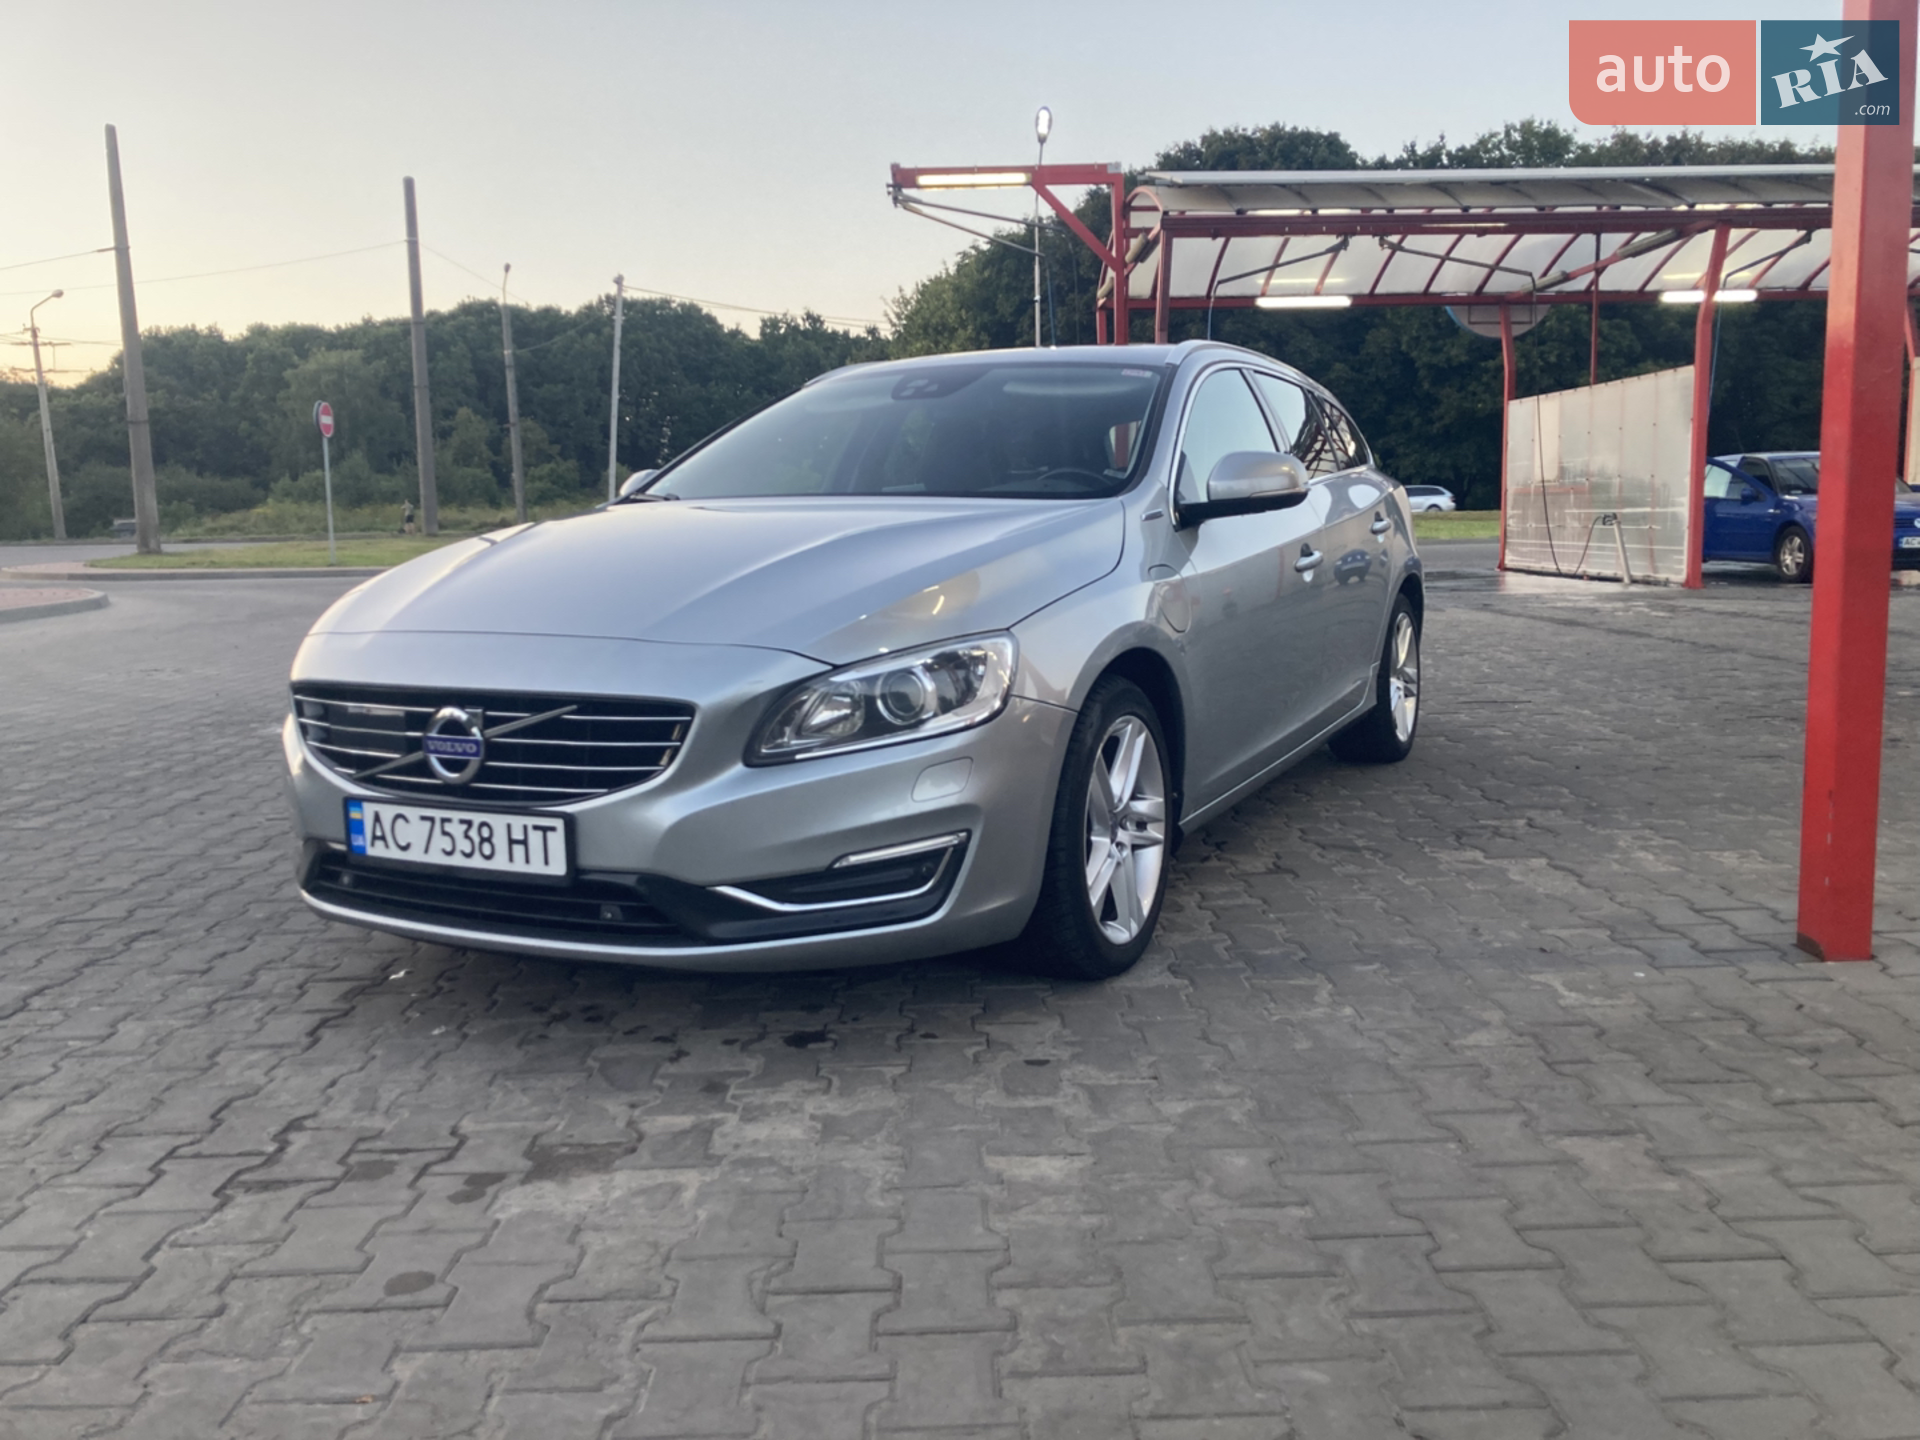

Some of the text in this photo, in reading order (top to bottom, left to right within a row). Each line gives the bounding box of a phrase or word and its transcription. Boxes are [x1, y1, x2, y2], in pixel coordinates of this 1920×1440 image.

[427, 741, 477, 754] VOLVO
[370, 810, 557, 866] AC 7538 HT
